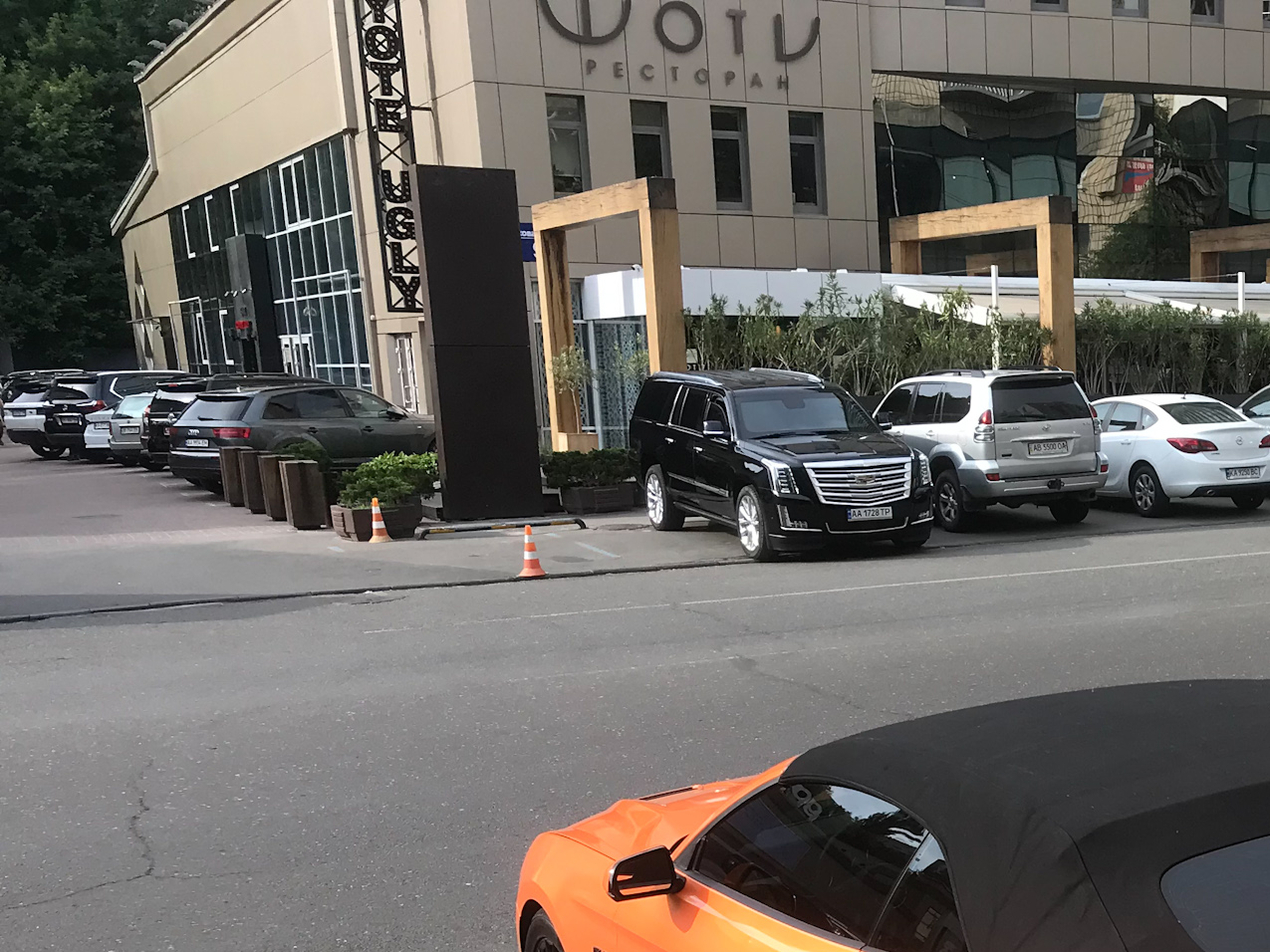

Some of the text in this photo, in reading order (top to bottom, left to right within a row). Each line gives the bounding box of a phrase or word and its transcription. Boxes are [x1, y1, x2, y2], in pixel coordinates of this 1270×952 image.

[585, 59, 790, 90] РЕСТОРАН
[381, 169, 421, 309] UGLY
[851, 510, 862, 518] AA
[863, 509, 880, 517] 1728
